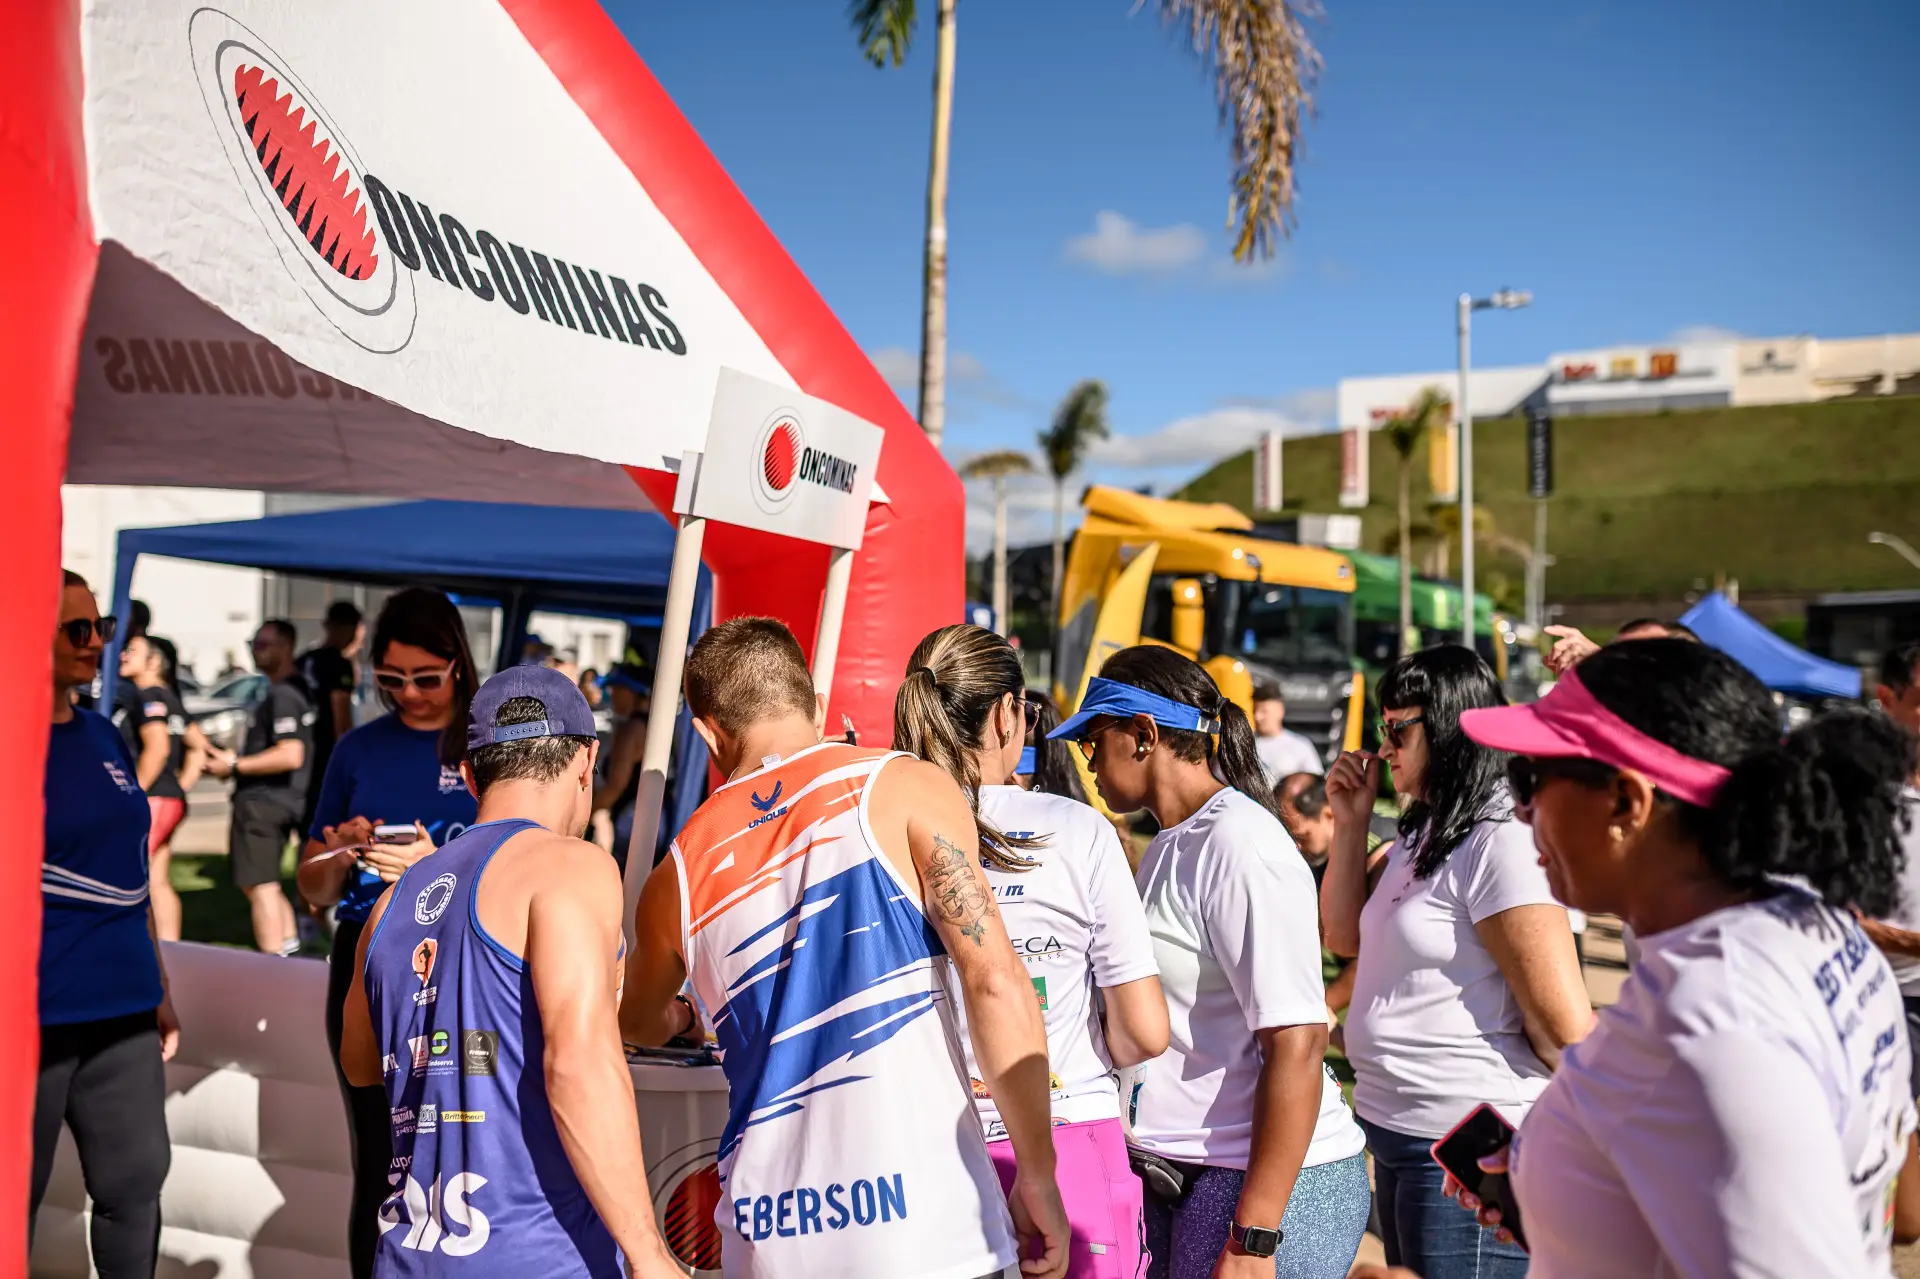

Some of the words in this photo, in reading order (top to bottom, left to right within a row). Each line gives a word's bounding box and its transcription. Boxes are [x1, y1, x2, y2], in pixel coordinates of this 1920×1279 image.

[364, 174, 687, 355] ONCOMINAS
[799, 447, 857, 494] ONCOMINAS
[748, 806, 788, 829] UNIQUE
[1005, 885, 1024, 896] ITL
[734, 1172, 907, 1242] EBERSON
